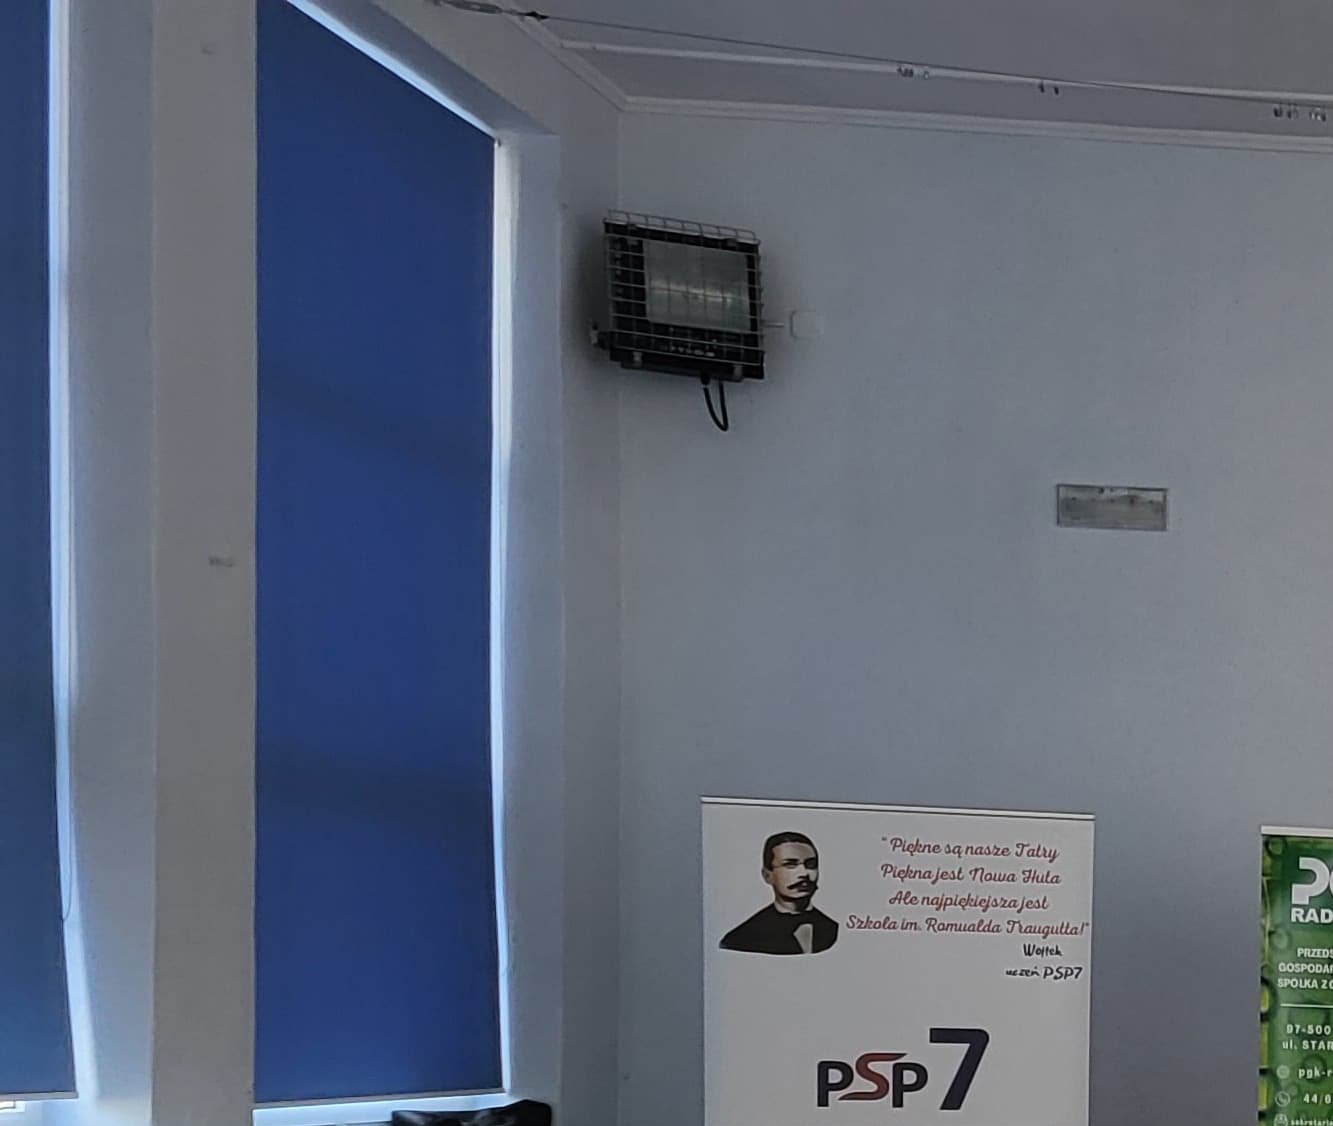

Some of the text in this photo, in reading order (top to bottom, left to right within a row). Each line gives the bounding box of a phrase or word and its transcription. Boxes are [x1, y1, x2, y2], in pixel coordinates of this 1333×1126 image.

[944, 842, 963, 858] są
[964, 844, 1010, 857] nasze
[1014, 842, 1060, 863] Tatry
[880, 863, 1062, 885] Piękna jest Nowa Huta
[888, 890, 920, 905] Ale
[1016, 896, 1049, 914] jest
[900, 918, 922, 931] im.
[925, 917, 1002, 935] Romualda
[1042, 966, 1084, 981] PSP7
[1286, 1023, 1332, 1035] 97-500
[1282, 1038, 1298, 1050] ul.
